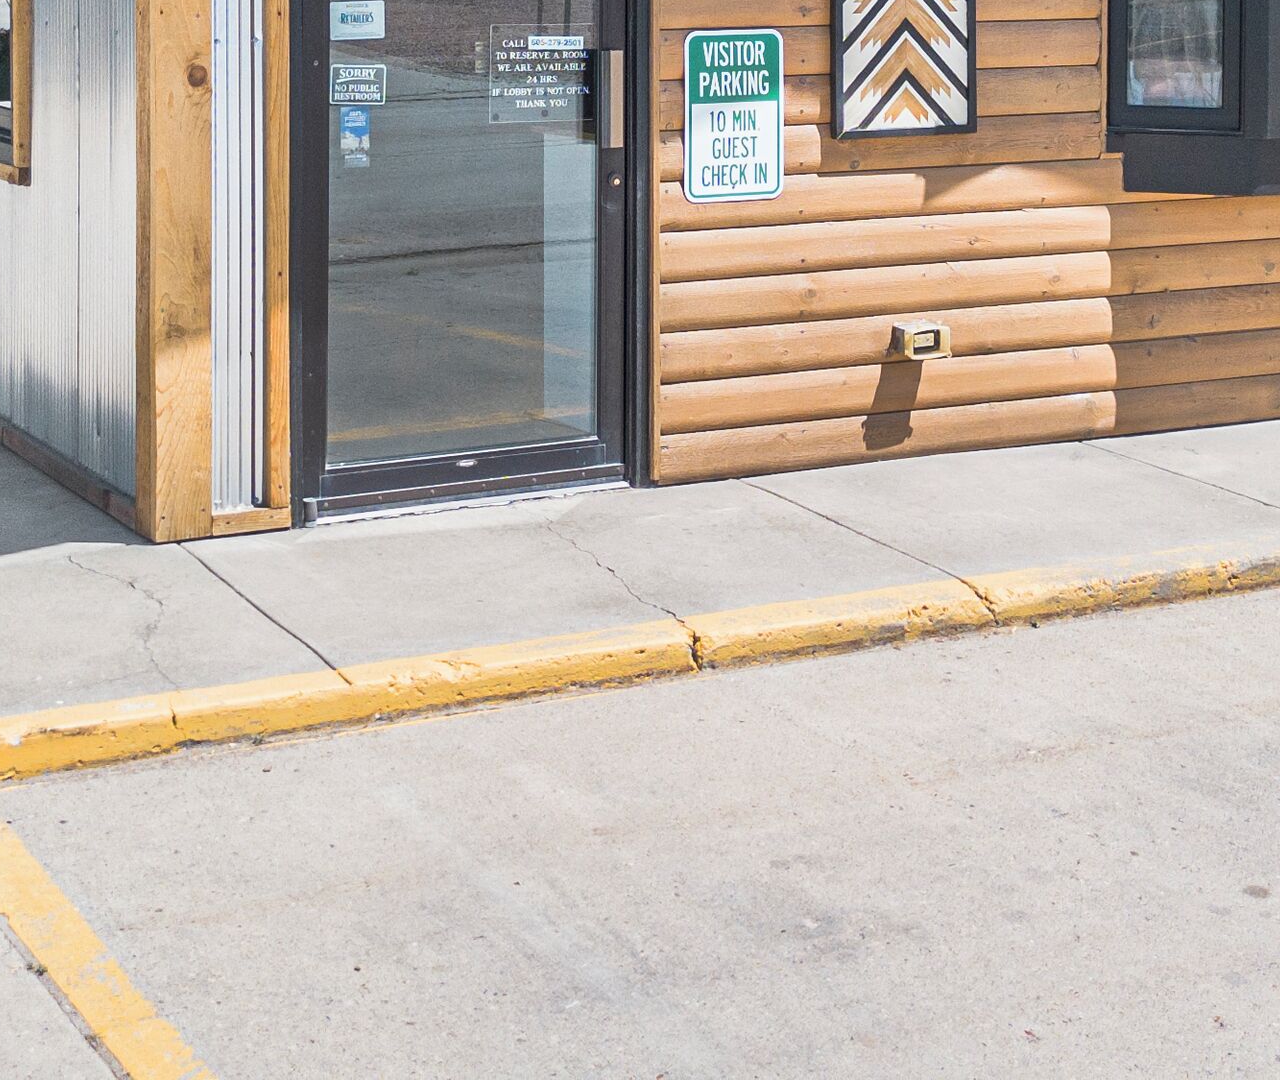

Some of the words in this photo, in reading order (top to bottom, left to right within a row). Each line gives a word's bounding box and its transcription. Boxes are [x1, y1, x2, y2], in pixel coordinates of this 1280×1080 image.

[502, 39, 526, 48] CALL
[496, 51, 507, 60] TO
[509, 51, 550, 59] RESERVE
[553, 51, 560, 59] A
[562, 50, 589, 59] ROOM
[703, 41, 766, 67] VISITOR
[497, 63, 511, 72] WE
[514, 63, 533, 72] ARE
[535, 63, 586, 71] AVAILABLE
[339, 68, 377, 79] SORRY
[526, 75, 537, 83] 24
[540, 75, 558, 83] HRS
[699, 70, 770, 97] PARKING
[335, 84, 347, 92] NO
[349, 84, 380, 92] PUBLIC
[492, 88, 500, 96] IF
[504, 88, 533, 96] LOBBY
[547, 87, 564, 95] NOT
[566, 86, 590, 95] OPEN
[334, 92, 381, 101] RESTROOM
[515, 100, 546, 108] THANK
[549, 99, 568, 107] YOU
[709, 110, 726, 132] 10
[712, 136, 758, 159] GUEST
[701, 163, 748, 187] CHECK
[754, 162, 768, 185] IN
